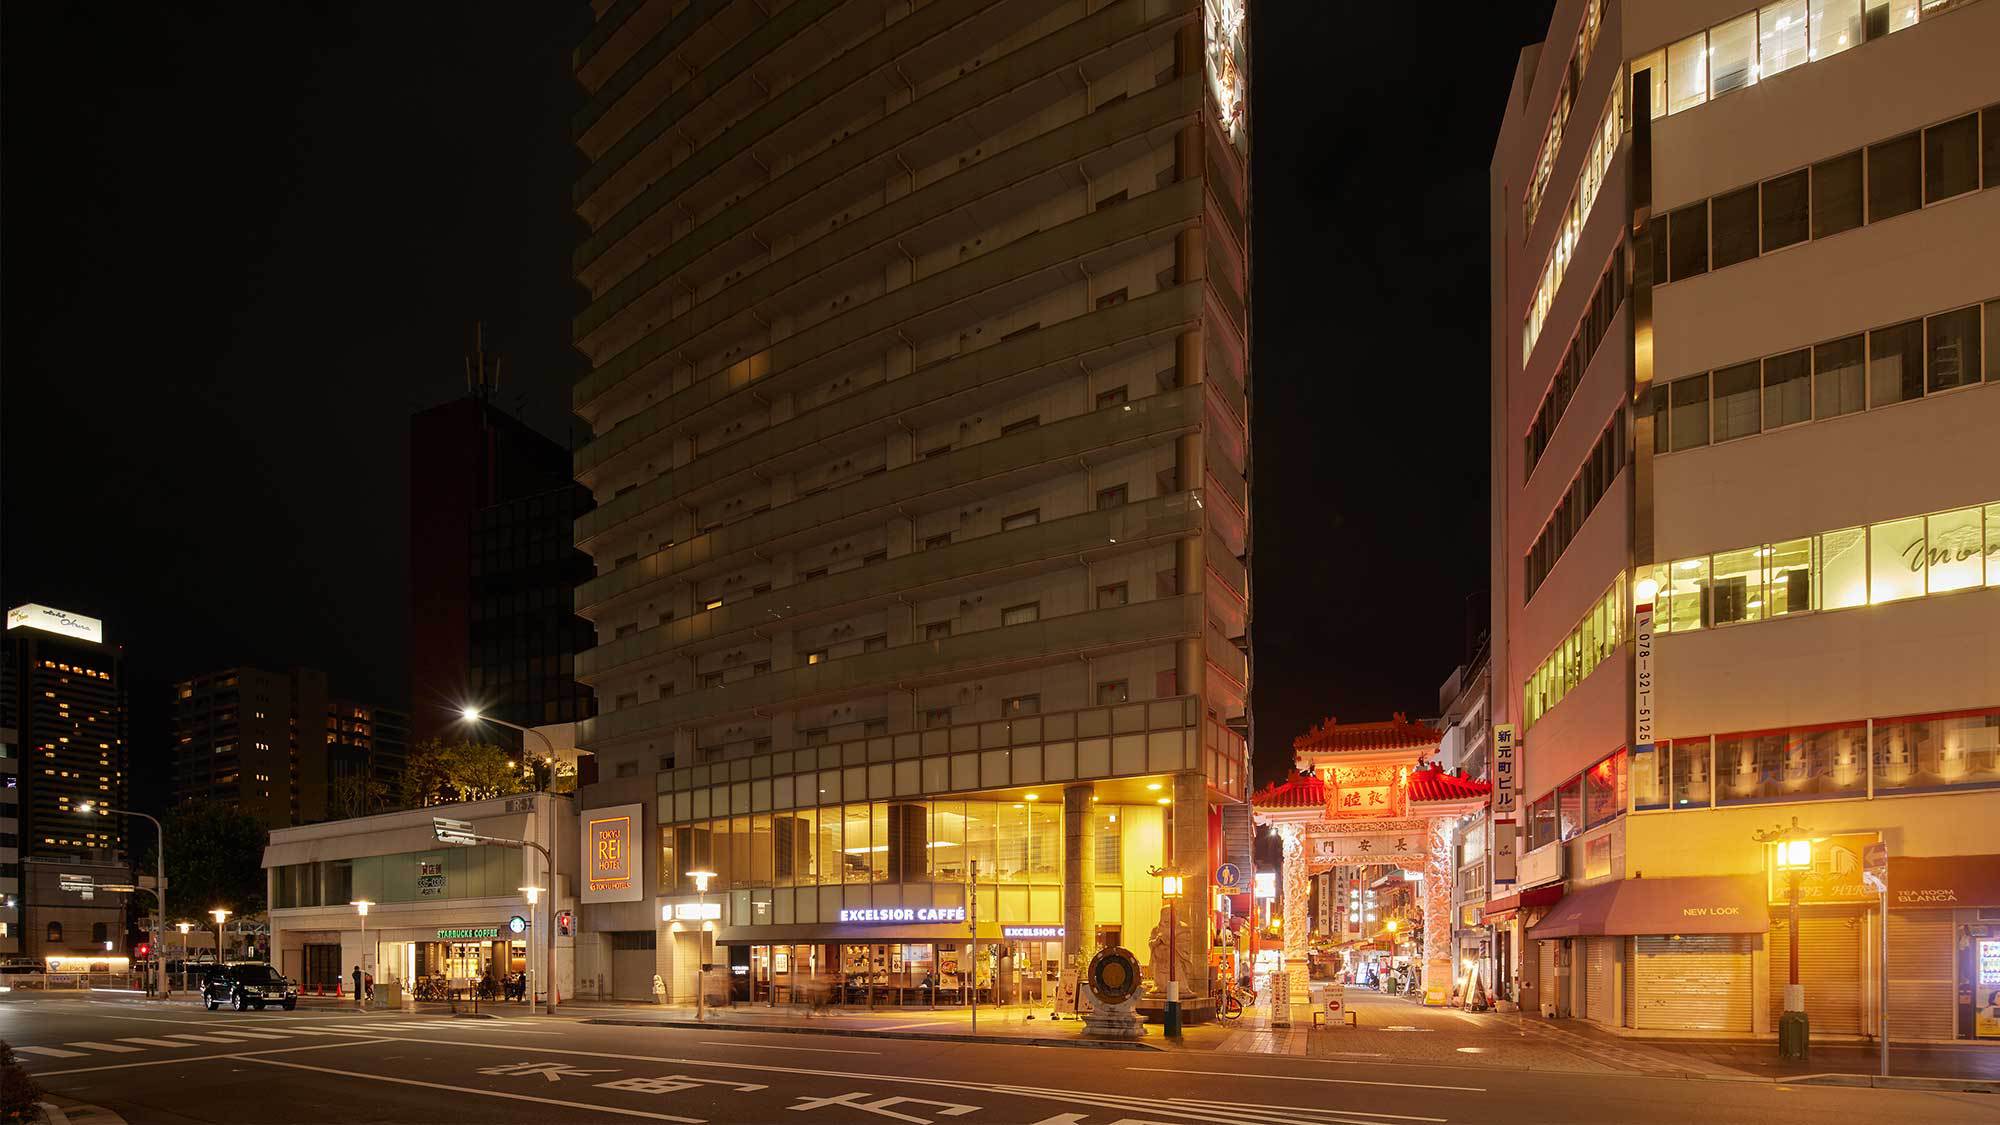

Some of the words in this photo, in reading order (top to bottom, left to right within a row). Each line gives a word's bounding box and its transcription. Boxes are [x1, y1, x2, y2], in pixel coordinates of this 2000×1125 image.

[1640, 633, 1650, 741] 078-321-5125
[1498, 730, 1513, 805] 新元町ビル
[599, 830, 620, 840] TOKYU
[599, 839, 620, 860] REI
[599, 861, 621, 870] HOTEL
[840, 909, 914, 922] EXCELSIOR
[917, 906, 965, 921] CAFFÉ
[1683, 908, 1706, 916] NEW
[1710, 907, 1739, 915] LOOK
[437, 929, 473, 939] STARBUCKS
[473, 928, 498, 938] COFFEE
[1005, 927, 1056, 937] EXCELSIOR
